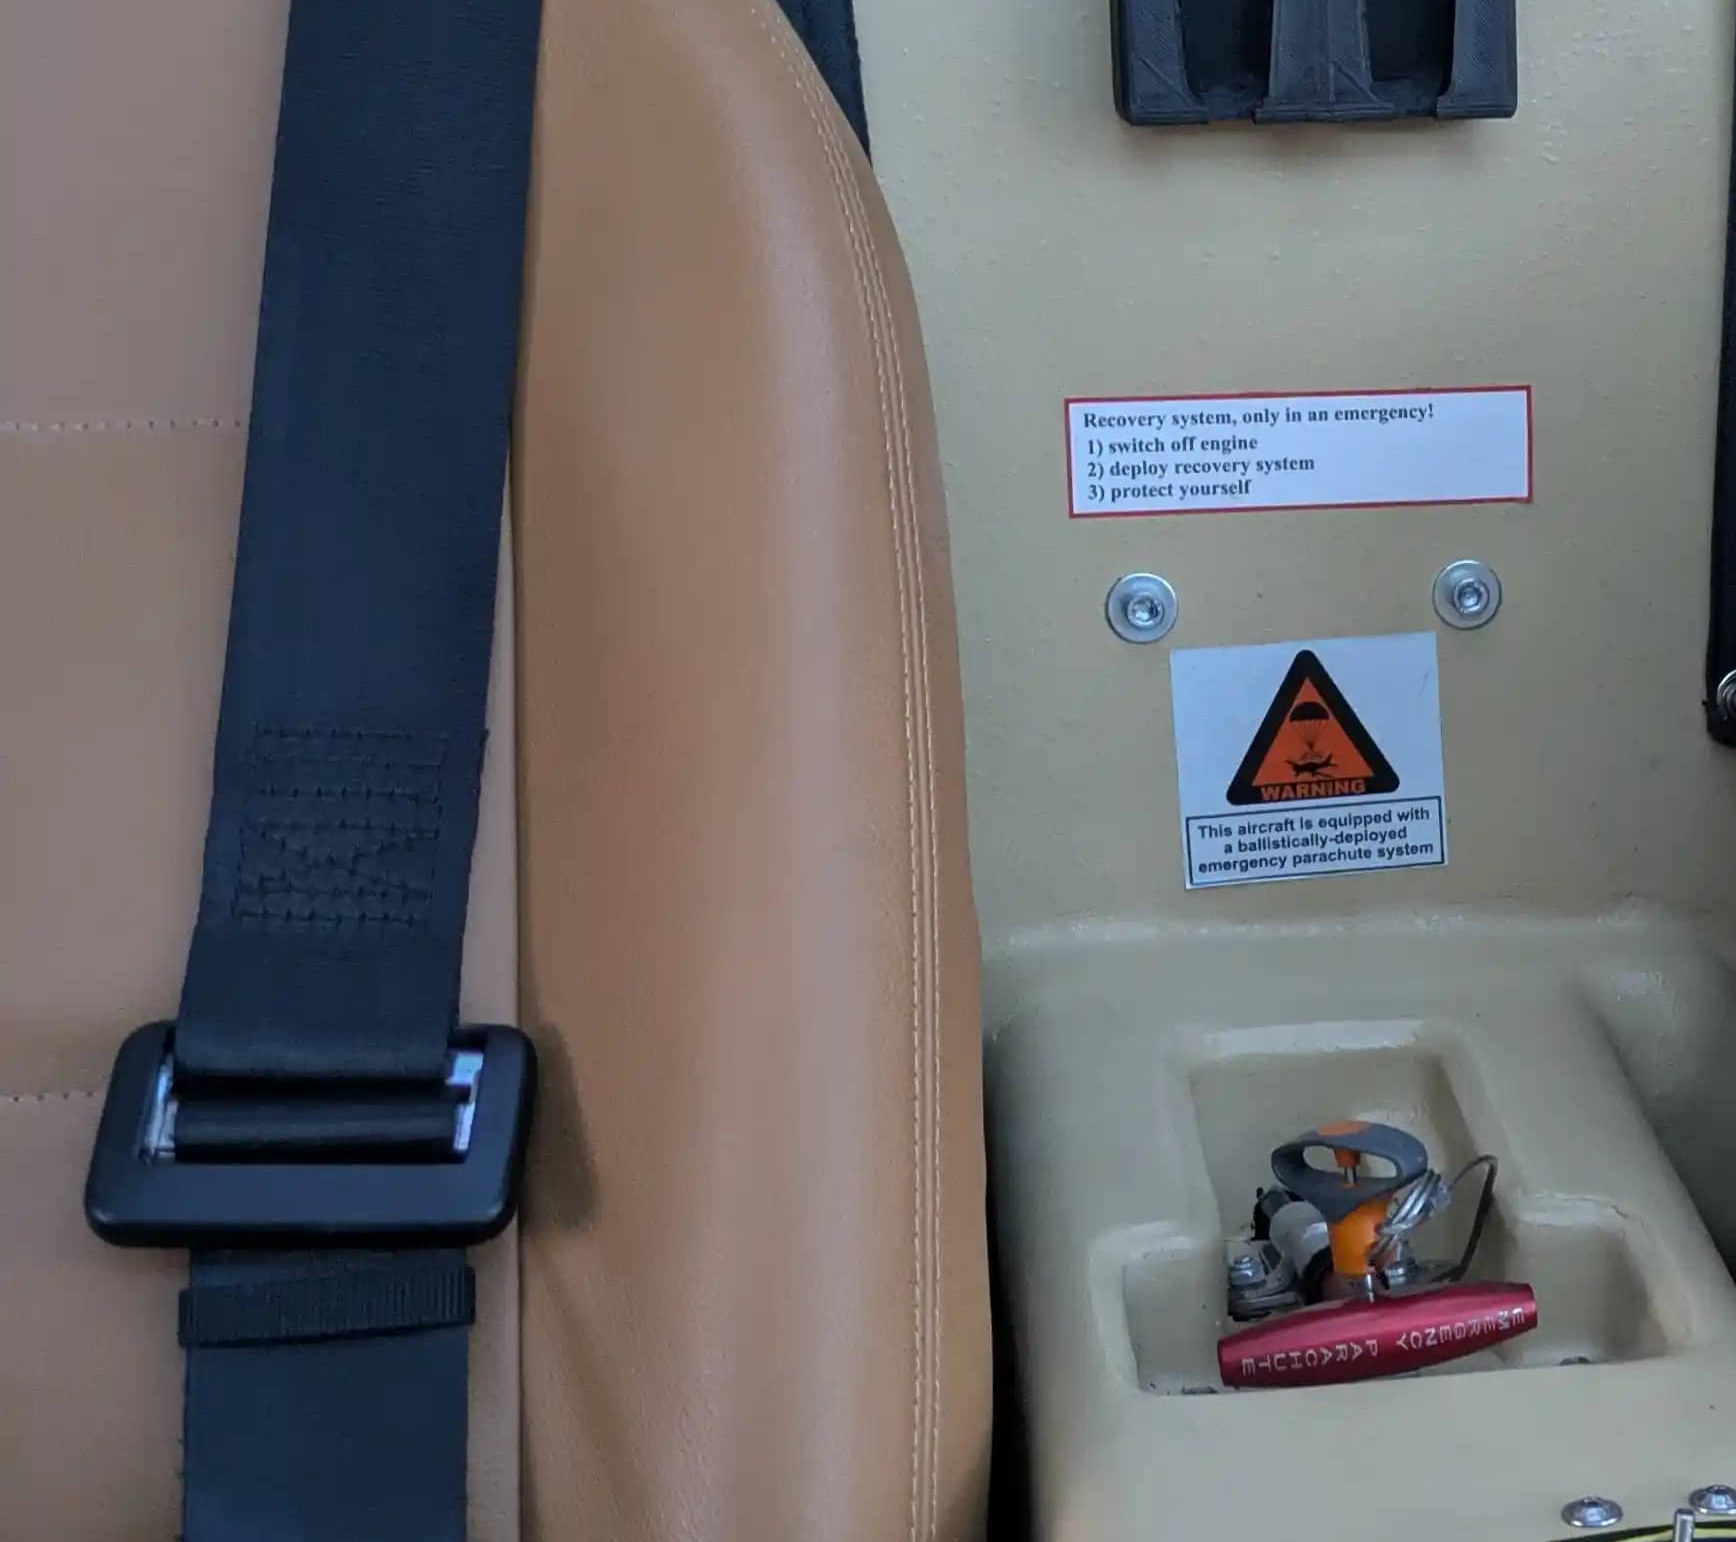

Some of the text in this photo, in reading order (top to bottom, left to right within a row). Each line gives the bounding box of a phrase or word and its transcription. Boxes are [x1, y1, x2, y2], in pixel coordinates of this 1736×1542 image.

[1083, 403, 1435, 430] Recovery system, only in an emergency!
[1087, 435, 1258, 457] 1) switch off engine
[1087, 456, 1315, 479] 2) deploy recovery system
[1087, 479, 1251, 503] 3) protect yourself
[1261, 779, 1366, 801] WARNING
[1198, 807, 1430, 839] This aircraft is equipped with
[1224, 827, 1408, 854] a ballistically-deployed
[1198, 842, 1434, 874] emergency parachute system
[1241, 1306, 1525, 1377] EMERGENCY PARACHUTE
